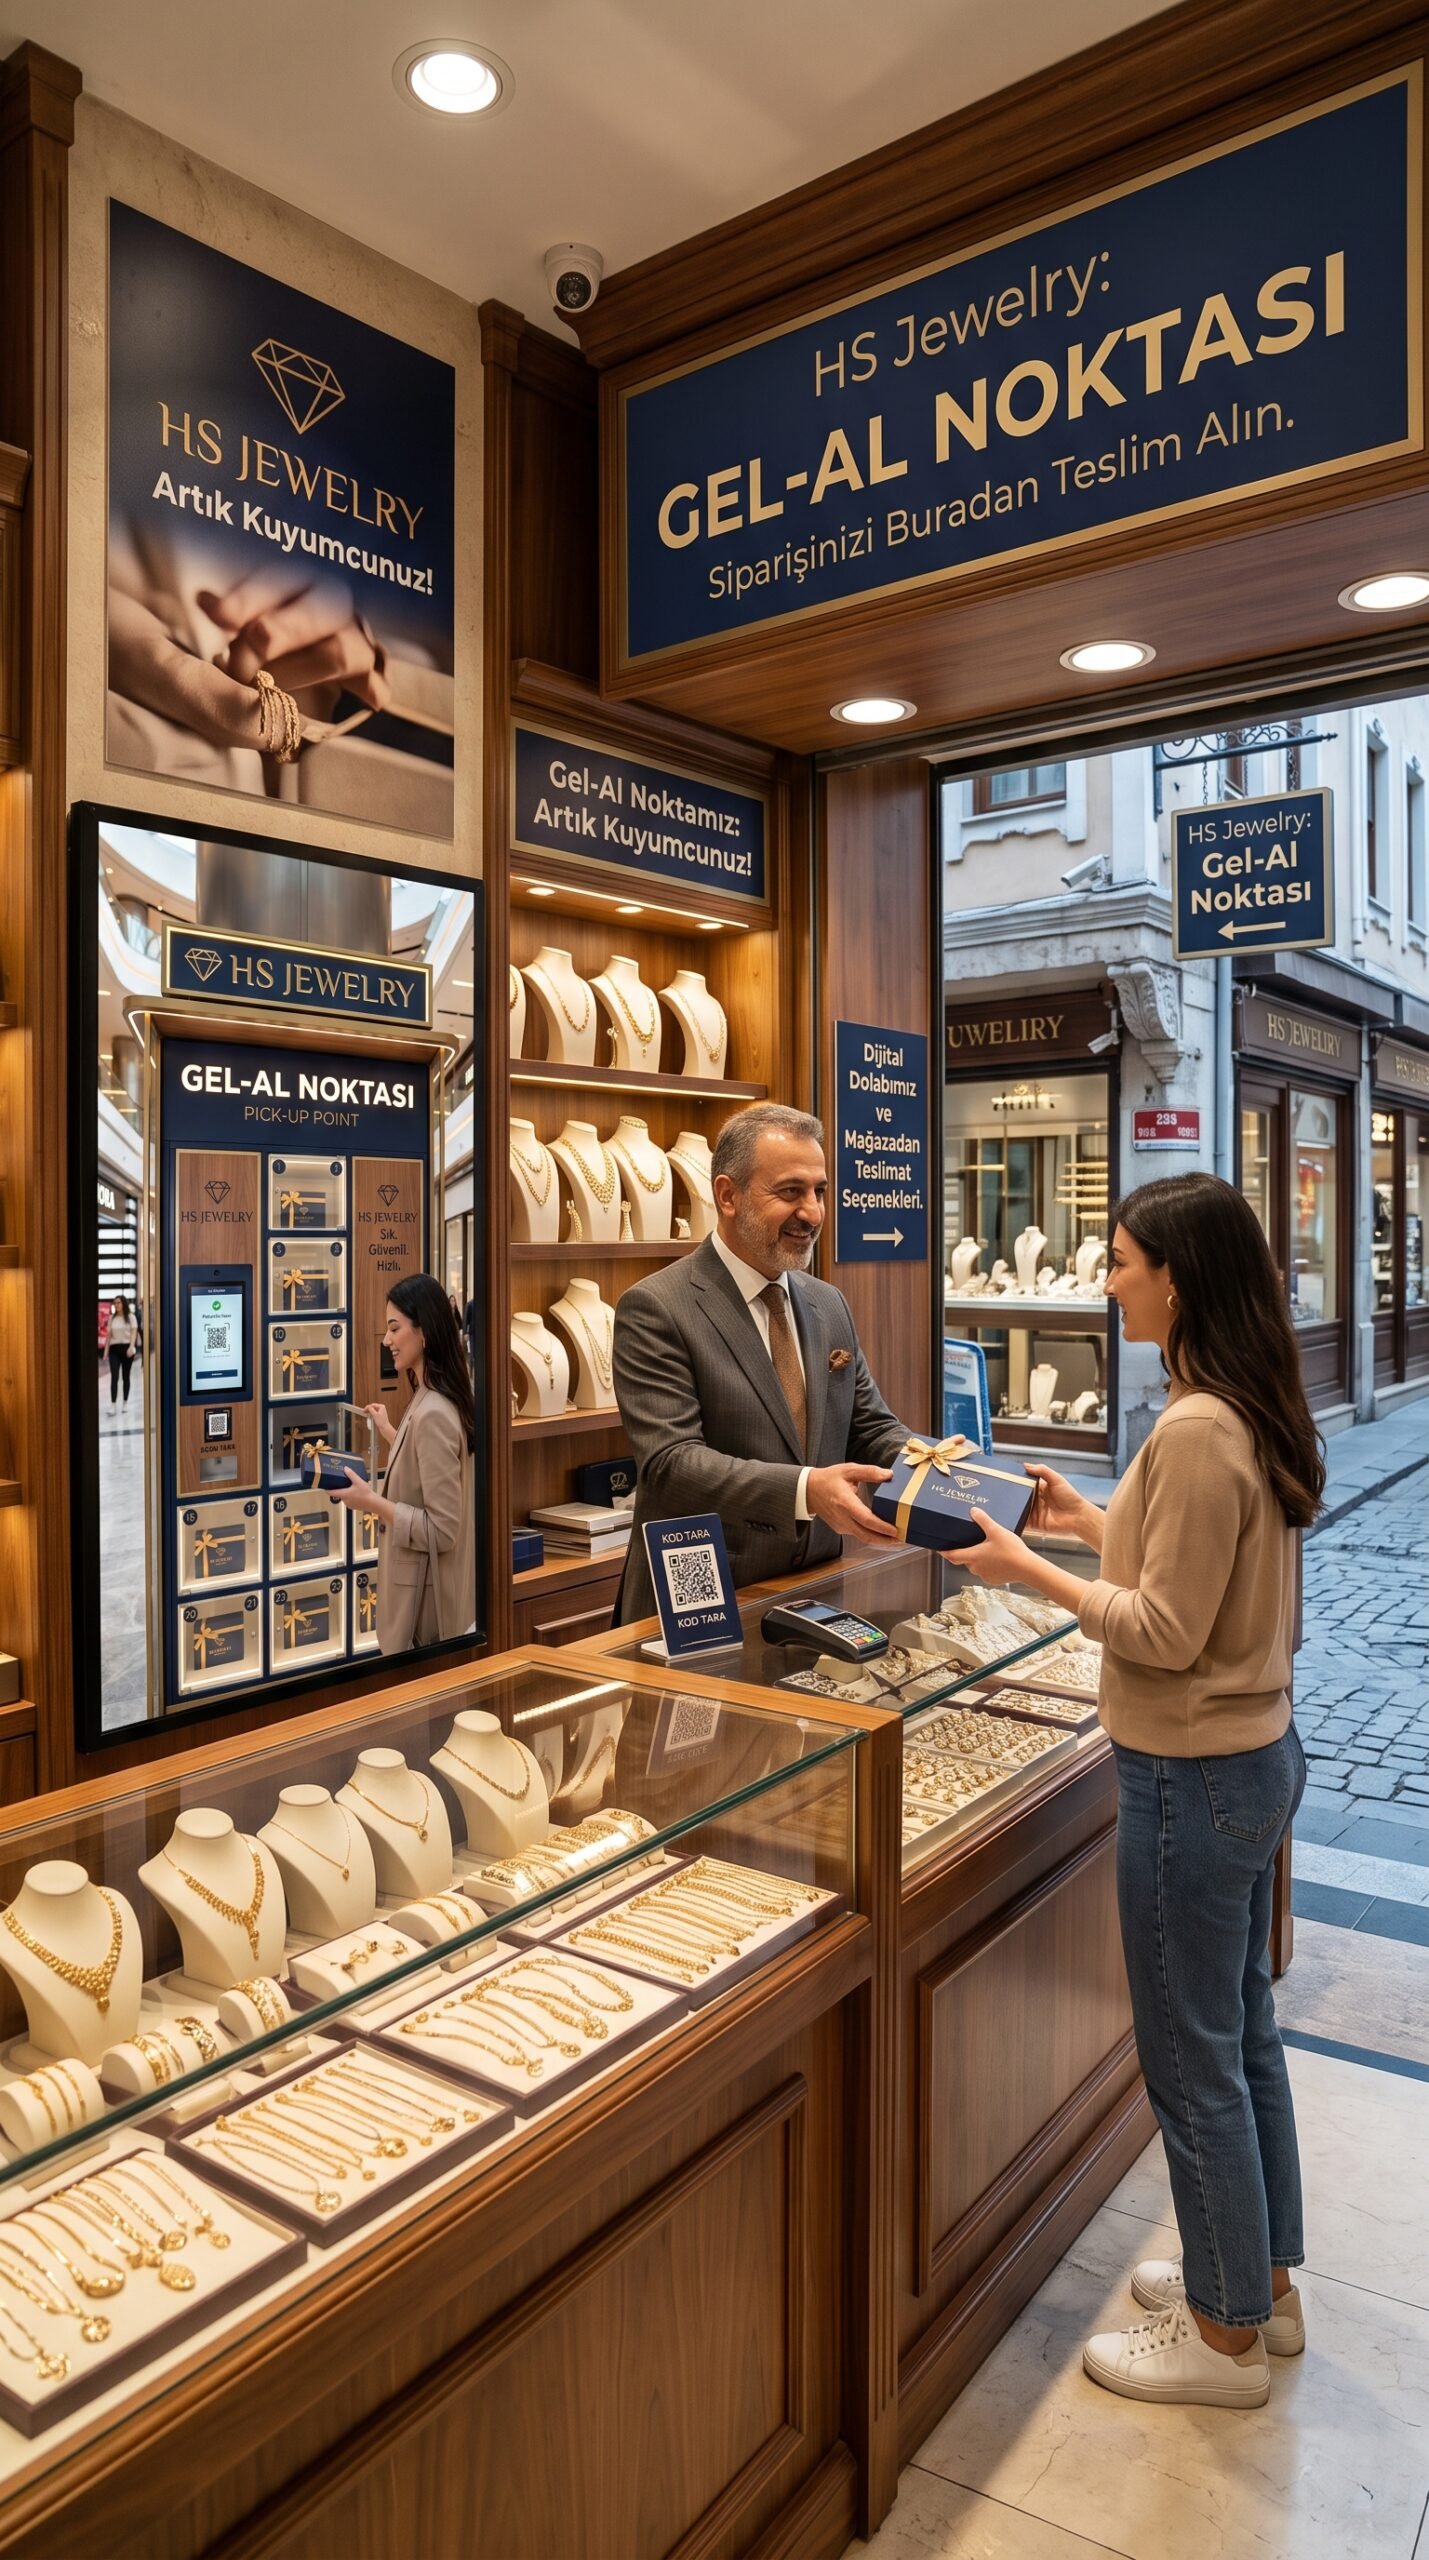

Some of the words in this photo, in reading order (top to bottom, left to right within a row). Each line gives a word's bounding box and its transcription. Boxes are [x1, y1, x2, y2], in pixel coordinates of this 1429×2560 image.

[815, 331, 878, 397] HS
[893, 251, 1110, 367] Jewelry:
[657, 414, 908, 549] GEL-AL
[935, 250, 1344, 465] NOKTASI
[157, 401, 222, 465] HS
[235, 435, 423, 540] JEWELRY
[708, 516, 873, 600] Siparişinizi
[887, 476, 1038, 547] Buradan
[1051, 432, 1182, 495] Teslim
[1195, 402, 1294, 455] Alın.
[152, 471, 234, 526] Artık
[243, 501, 433, 595] Kuyumcunuz!
[549, 760, 622, 804] Gel-Al
[631, 782, 741, 837] Noktamız:
[533, 798, 596, 838] Artık
[604, 814, 752, 876] Kuyumcunuz!
[1188, 822, 1217, 845] HS
[1222, 810, 1311, 840] Jewelry:
[1202, 840, 1297, 879] Gel-Al
[1191, 881, 1311, 915] Noktası
[230, 954, 274, 989] HS
[283, 962, 415, 1008] JEWELRY
[863, 1042, 904, 1069] Dijital
[181, 1063, 290, 1098] GEL-AL
[299, 1074, 414, 1108] NOKTASI
[849, 1070, 917, 1097] Dolabımız
[244, 1106, 309, 1124] PICK-UP
[314, 1111, 359, 1127] POINT
[876, 1107, 892, 1122] ve
[844, 1129, 920, 1154] Mağazadan
[855, 1159, 911, 1181] Teslimat
[181, 1211, 199, 1223] HS
[201, 1211, 254, 1223] JEWELRY
[842, 1188, 924, 1213] Seçenekleri.
[358, 1212, 371, 1222] HS
[374, 1212, 418, 1224] JEWELRY
[662, 1531, 683, 1544] KOD
[684, 1529, 711, 1541] TARA
[677, 1616, 699, 1629] KOD
[700, 1612, 727, 1625] TARA
